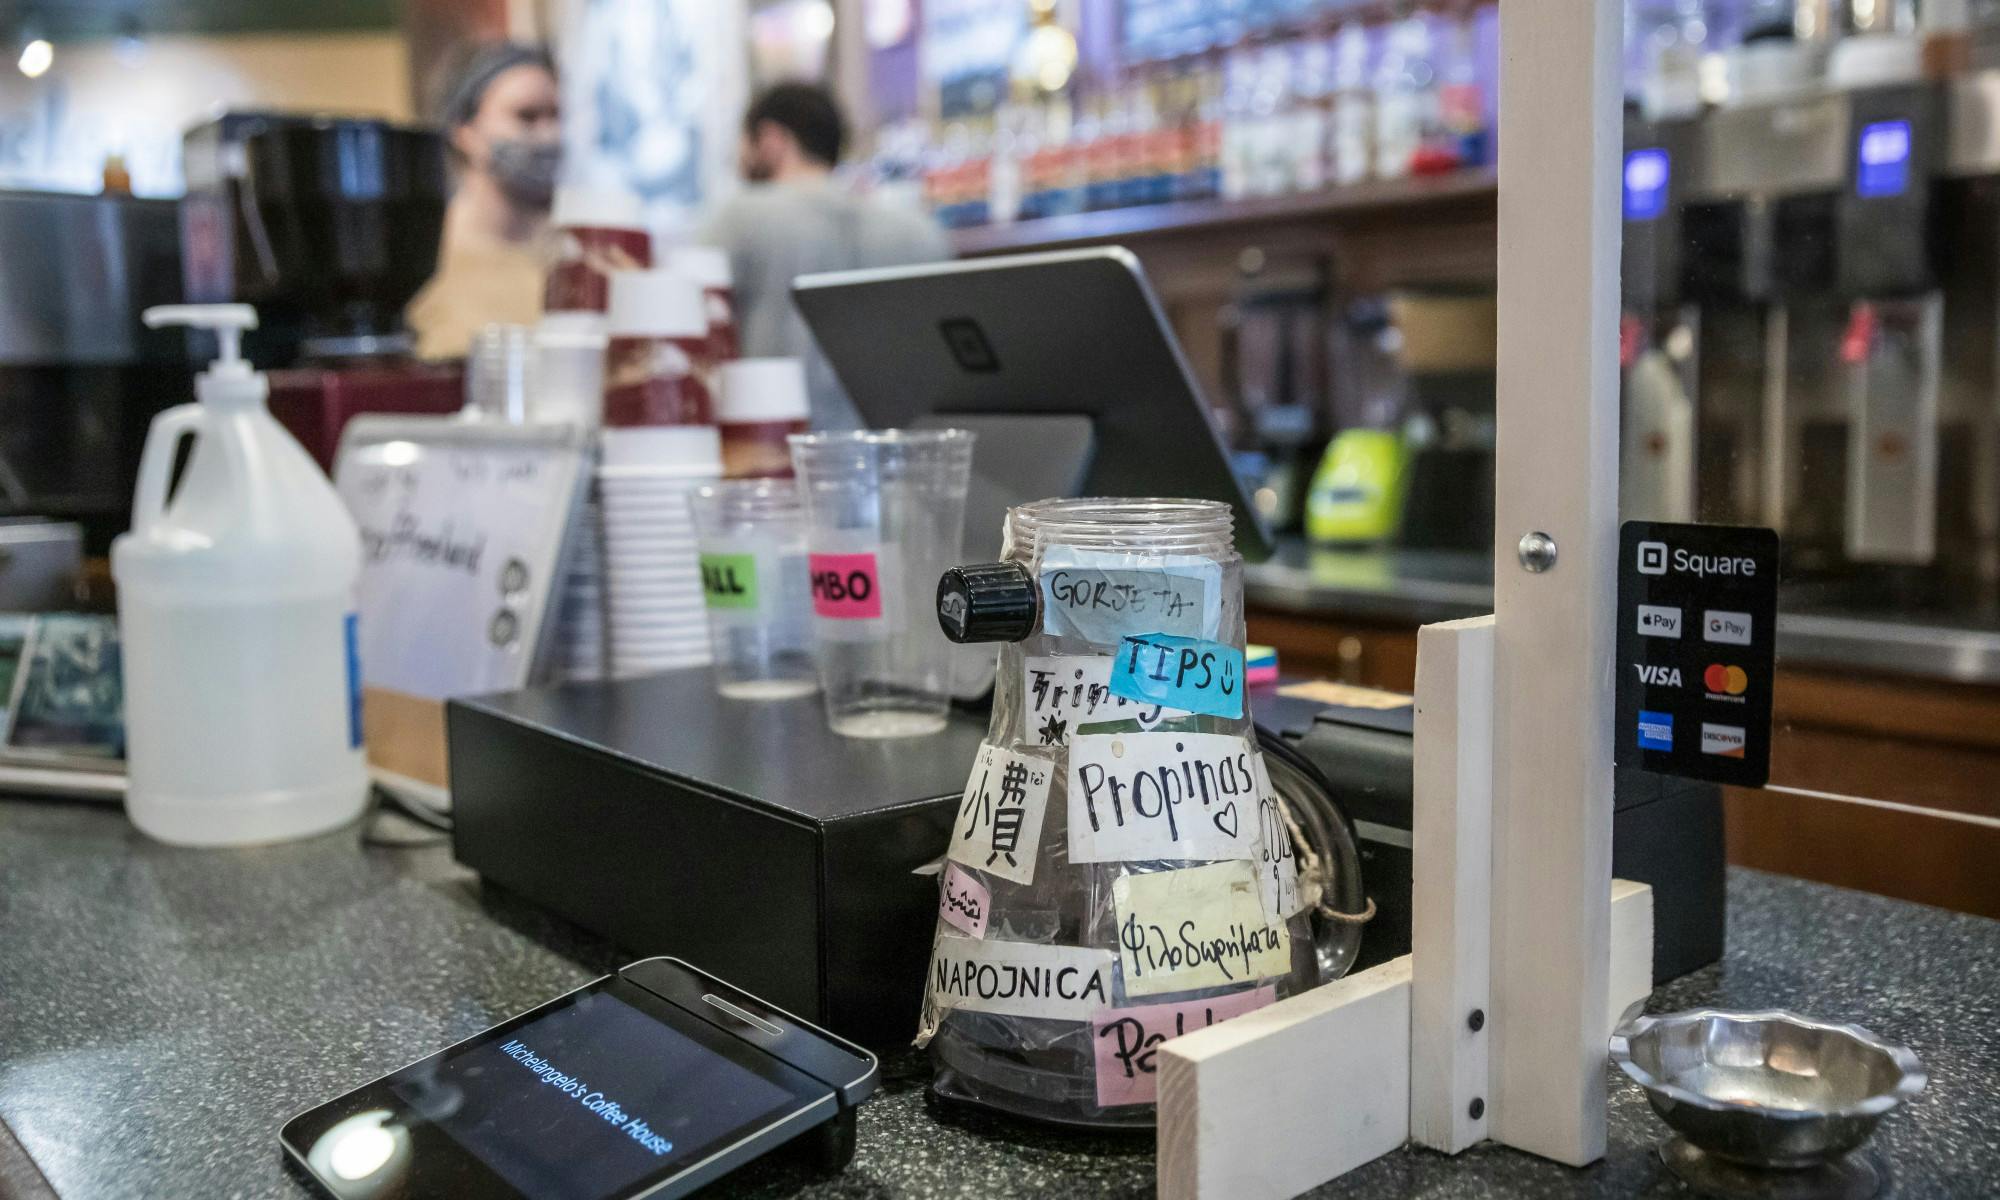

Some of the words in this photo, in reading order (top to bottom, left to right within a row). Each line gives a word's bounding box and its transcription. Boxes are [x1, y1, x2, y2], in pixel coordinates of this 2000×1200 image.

[1673, 548, 1757, 578] Square
[1051, 571, 1195, 618] GORJETA
[1653, 614, 1677, 630] Pay
[1724, 621, 1746, 637] Pay
[1123, 635, 1216, 690] TIPS
[1633, 663, 1683, 688] VISA
[1078, 742, 1253, 842] Propinas
[935, 958, 1107, 1004] NAPOJNICA
[499, 1039, 588, 1099] Michelangelo's
[581, 1092, 629, 1126] Coffee
[620, 1117, 673, 1156] House
